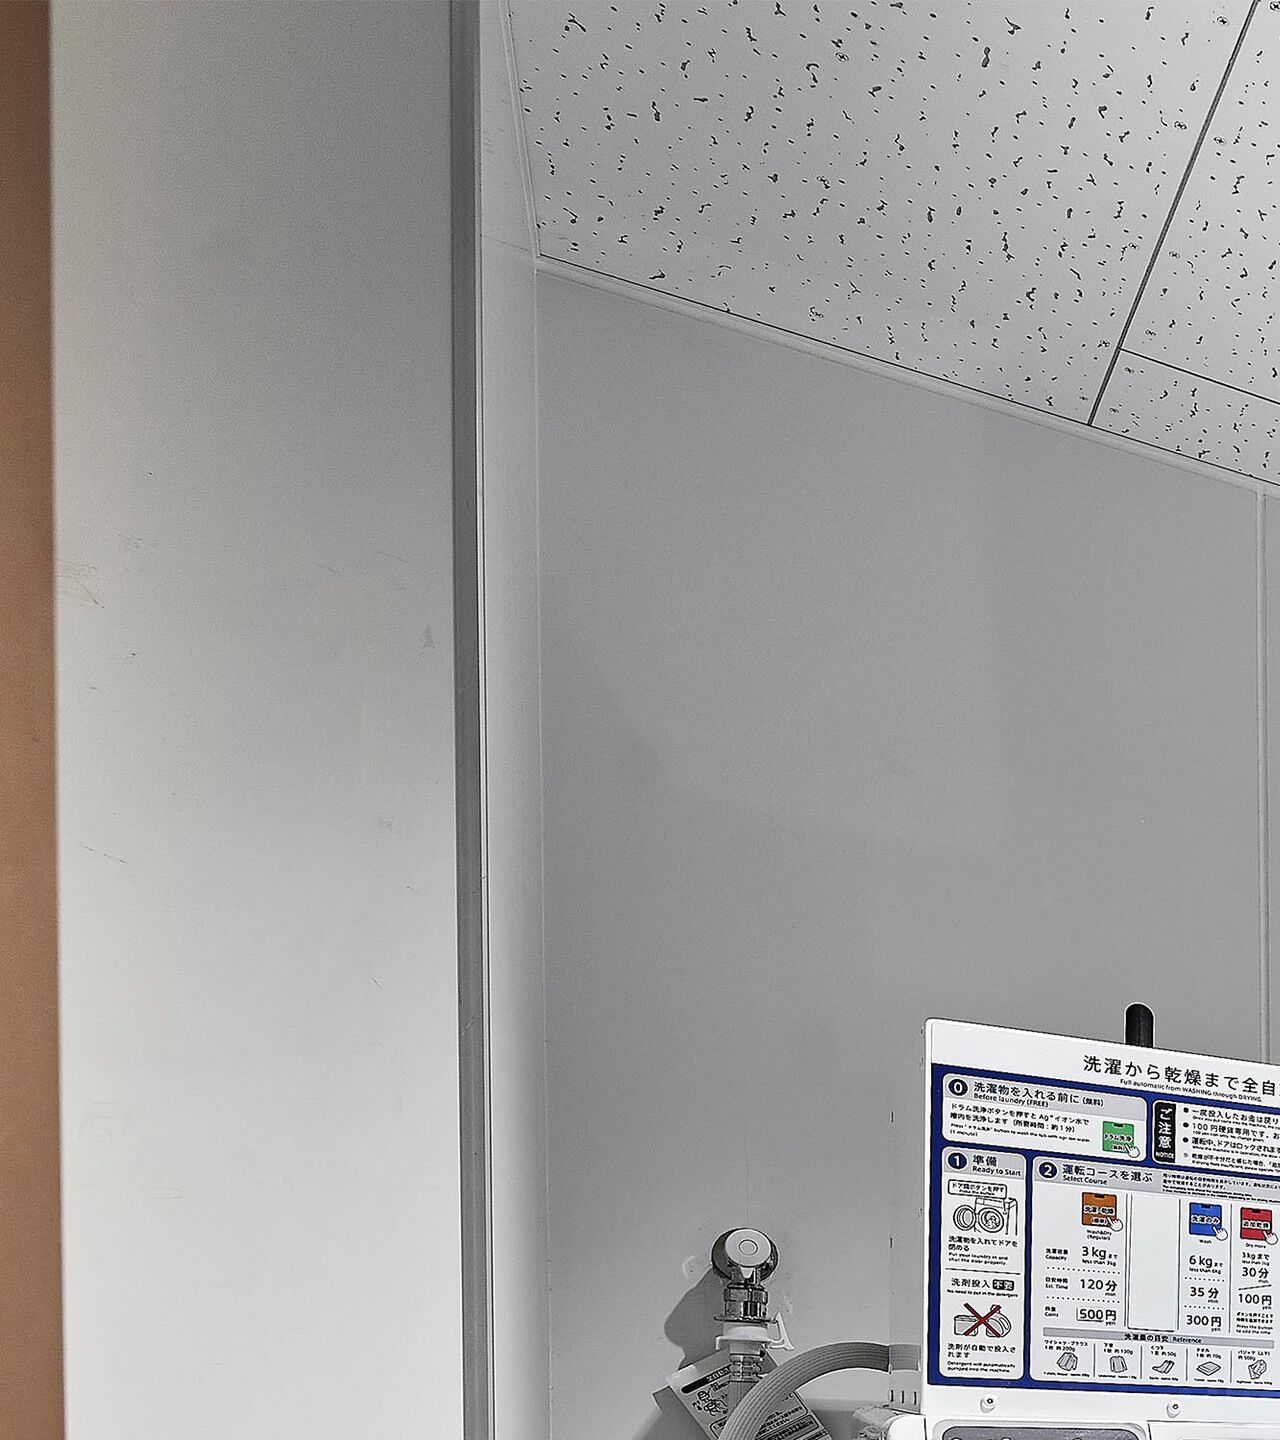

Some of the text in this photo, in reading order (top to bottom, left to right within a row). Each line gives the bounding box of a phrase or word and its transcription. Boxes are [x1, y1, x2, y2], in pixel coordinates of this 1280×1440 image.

[974, 1082, 1080, 1104] 洗濯物を入れる前に
[1182, 1085, 1212, 1097] WASHING
[974, 1092, 1049, 1108] Before laundry (FREE)
[1158, 1108, 1174, 1149] ご注意
[973, 1155, 997, 1167] 準備
[972, 1166, 995, 1174] Ready
[1062, 1164, 1153, 1182] 運転コースを選ぶ
[1063, 1175, 1107, 1186] Select Course
[949, 1235, 1018, 1247] 洗濯物を入れてドアを
[1082, 1246, 1106, 1260] 3kg
[1189, 1255, 1213, 1269] 6kg
[1241, 1267, 1269, 1279] 30分
[951, 1278, 990, 1289] 洗剤投入
[1080, 1279, 1118, 1292] 120分
[1189, 1286, 1219, 1298] 35分
[1238, 1293, 1272, 1306] 100円
[1079, 1309, 1117, 1321] 500円
[1186, 1314, 1222, 1328] 300円
[1172, 1336, 1202, 1344] Reference
[947, 1343, 1016, 1354] 洗剤が自動で投入さ
[947, 1351, 971, 1359] れます
